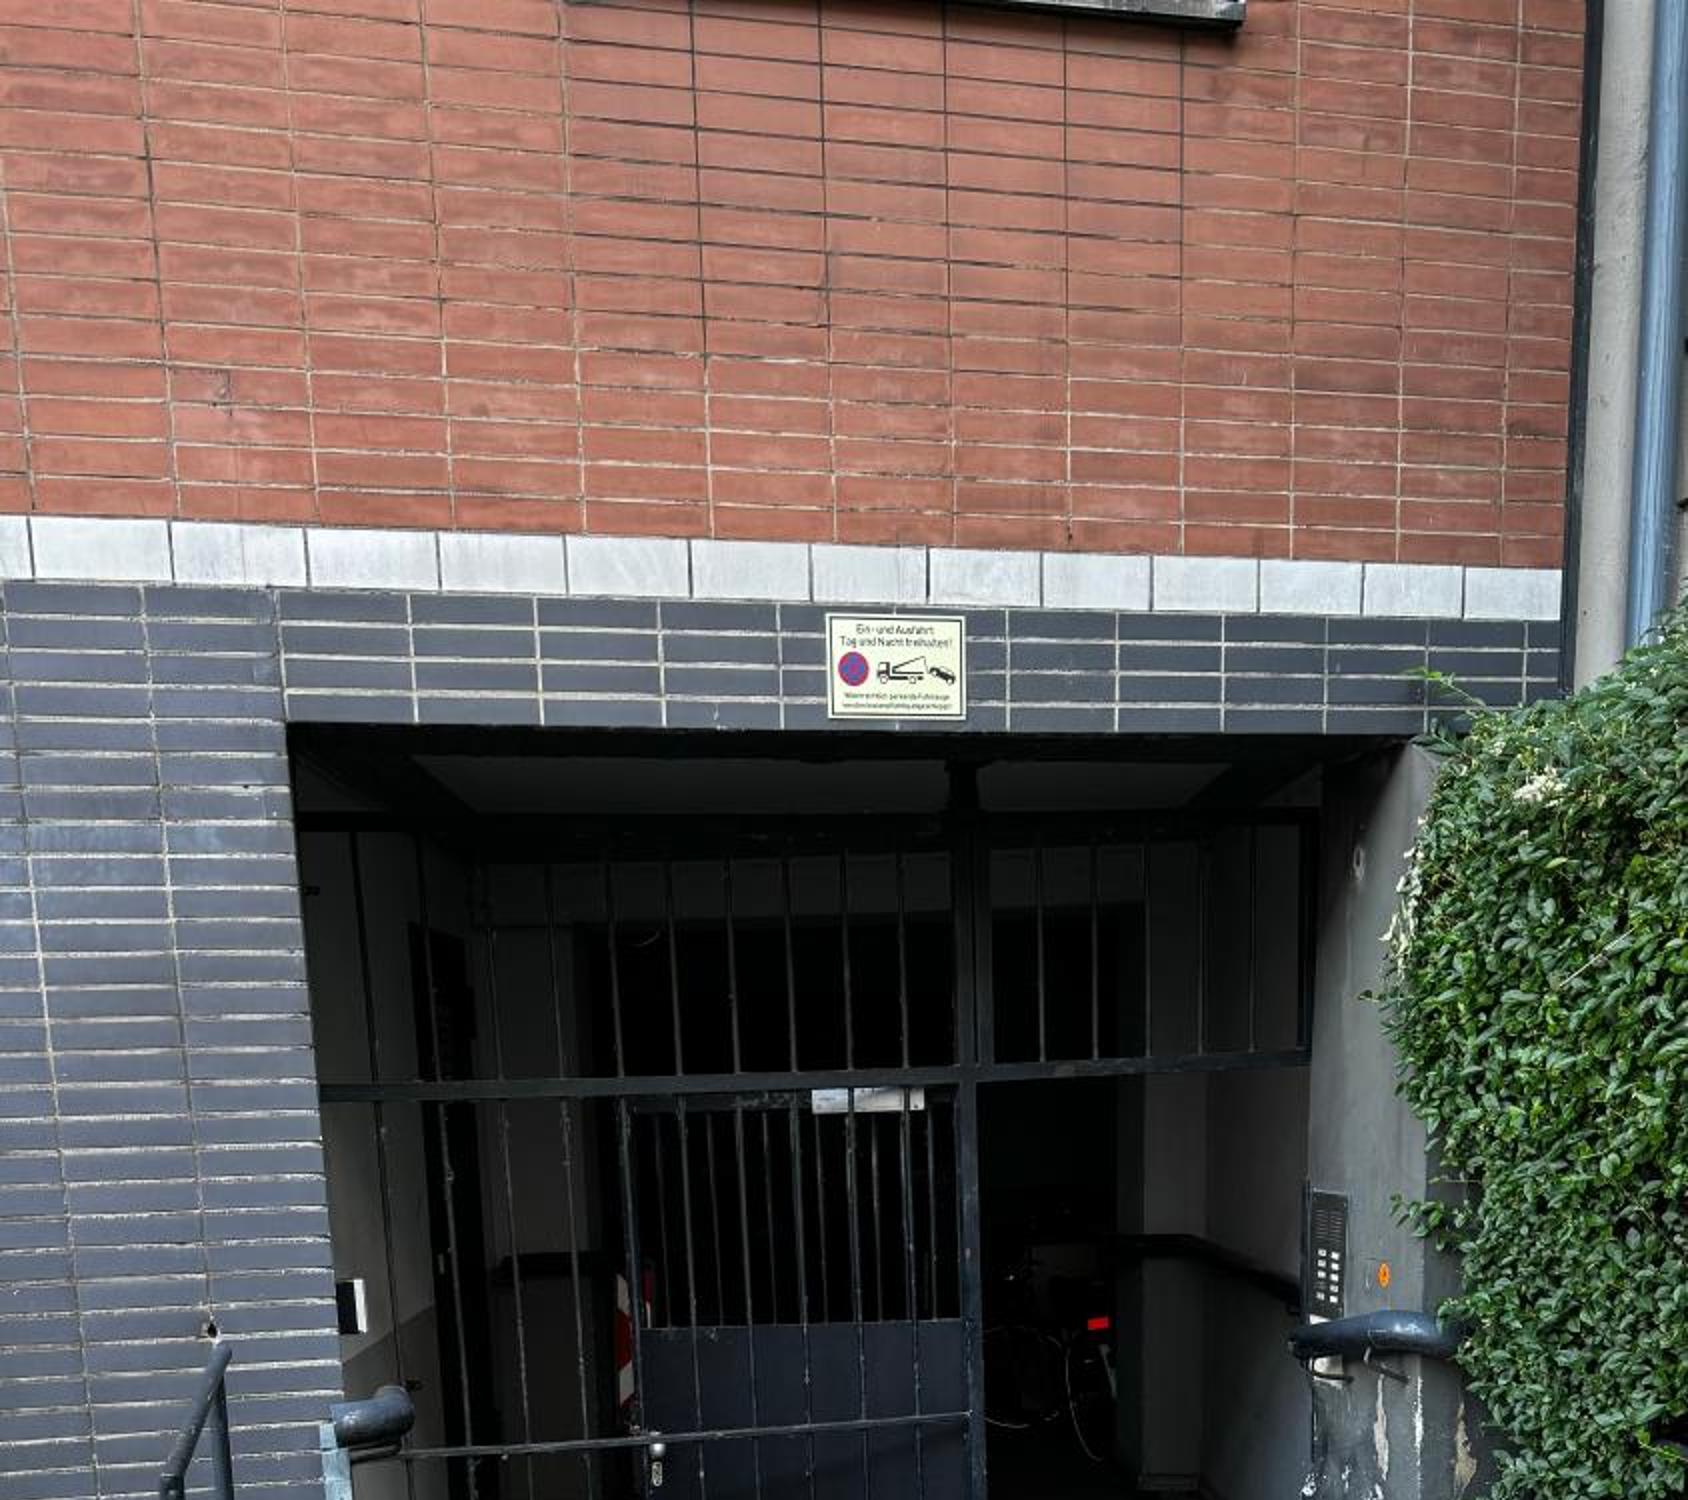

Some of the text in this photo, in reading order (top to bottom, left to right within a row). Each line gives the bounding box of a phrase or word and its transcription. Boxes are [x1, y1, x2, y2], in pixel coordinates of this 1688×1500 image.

[876, 624, 894, 634] und
[895, 625, 934, 635] Ausfahrt
[840, 635, 857, 648] Tag
[860, 637, 876, 646] und
[878, 637, 904, 647] Nacht
